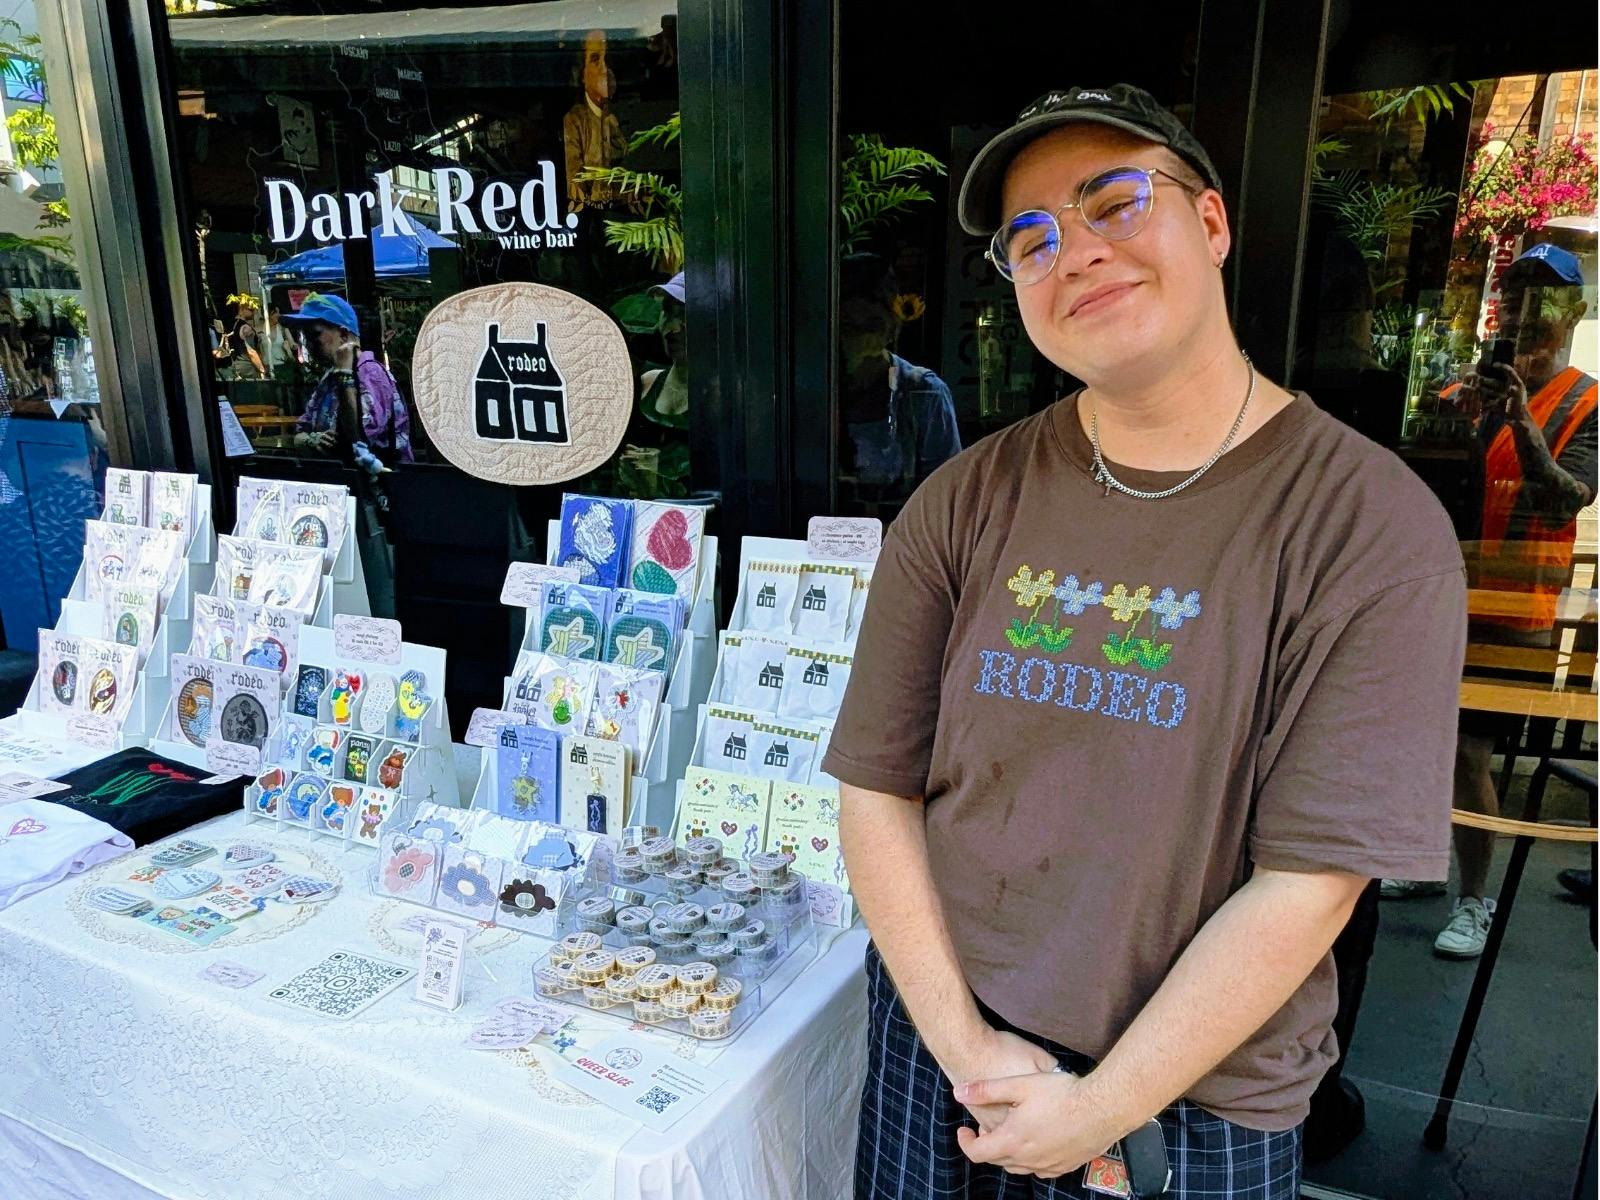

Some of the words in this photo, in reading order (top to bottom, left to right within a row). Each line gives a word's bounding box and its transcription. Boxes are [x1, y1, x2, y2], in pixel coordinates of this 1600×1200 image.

[340, 44, 369, 60] TUSCANY
[397, 68, 424, 82] MARCHE
[375, 87, 401, 101] UMBRIA
[384, 140, 401, 153] LAZIO
[265, 172, 417, 243] Dark
[432, 160, 579, 235] Red.
[498, 231, 541, 250] wine
[545, 230, 578, 248] bar
[507, 353, 546, 373] rodeo
[297, 491, 329, 506] rodeo
[117, 590, 144, 606] rodeo
[211, 604, 235, 620] rode
[253, 611, 286, 627] rdeo
[231, 671, 263, 690] rodeo
[973, 649, 1187, 729] RODEO
[576, 1057, 609, 1075] QUEER
[604, 1070, 635, 1088] SLICE
